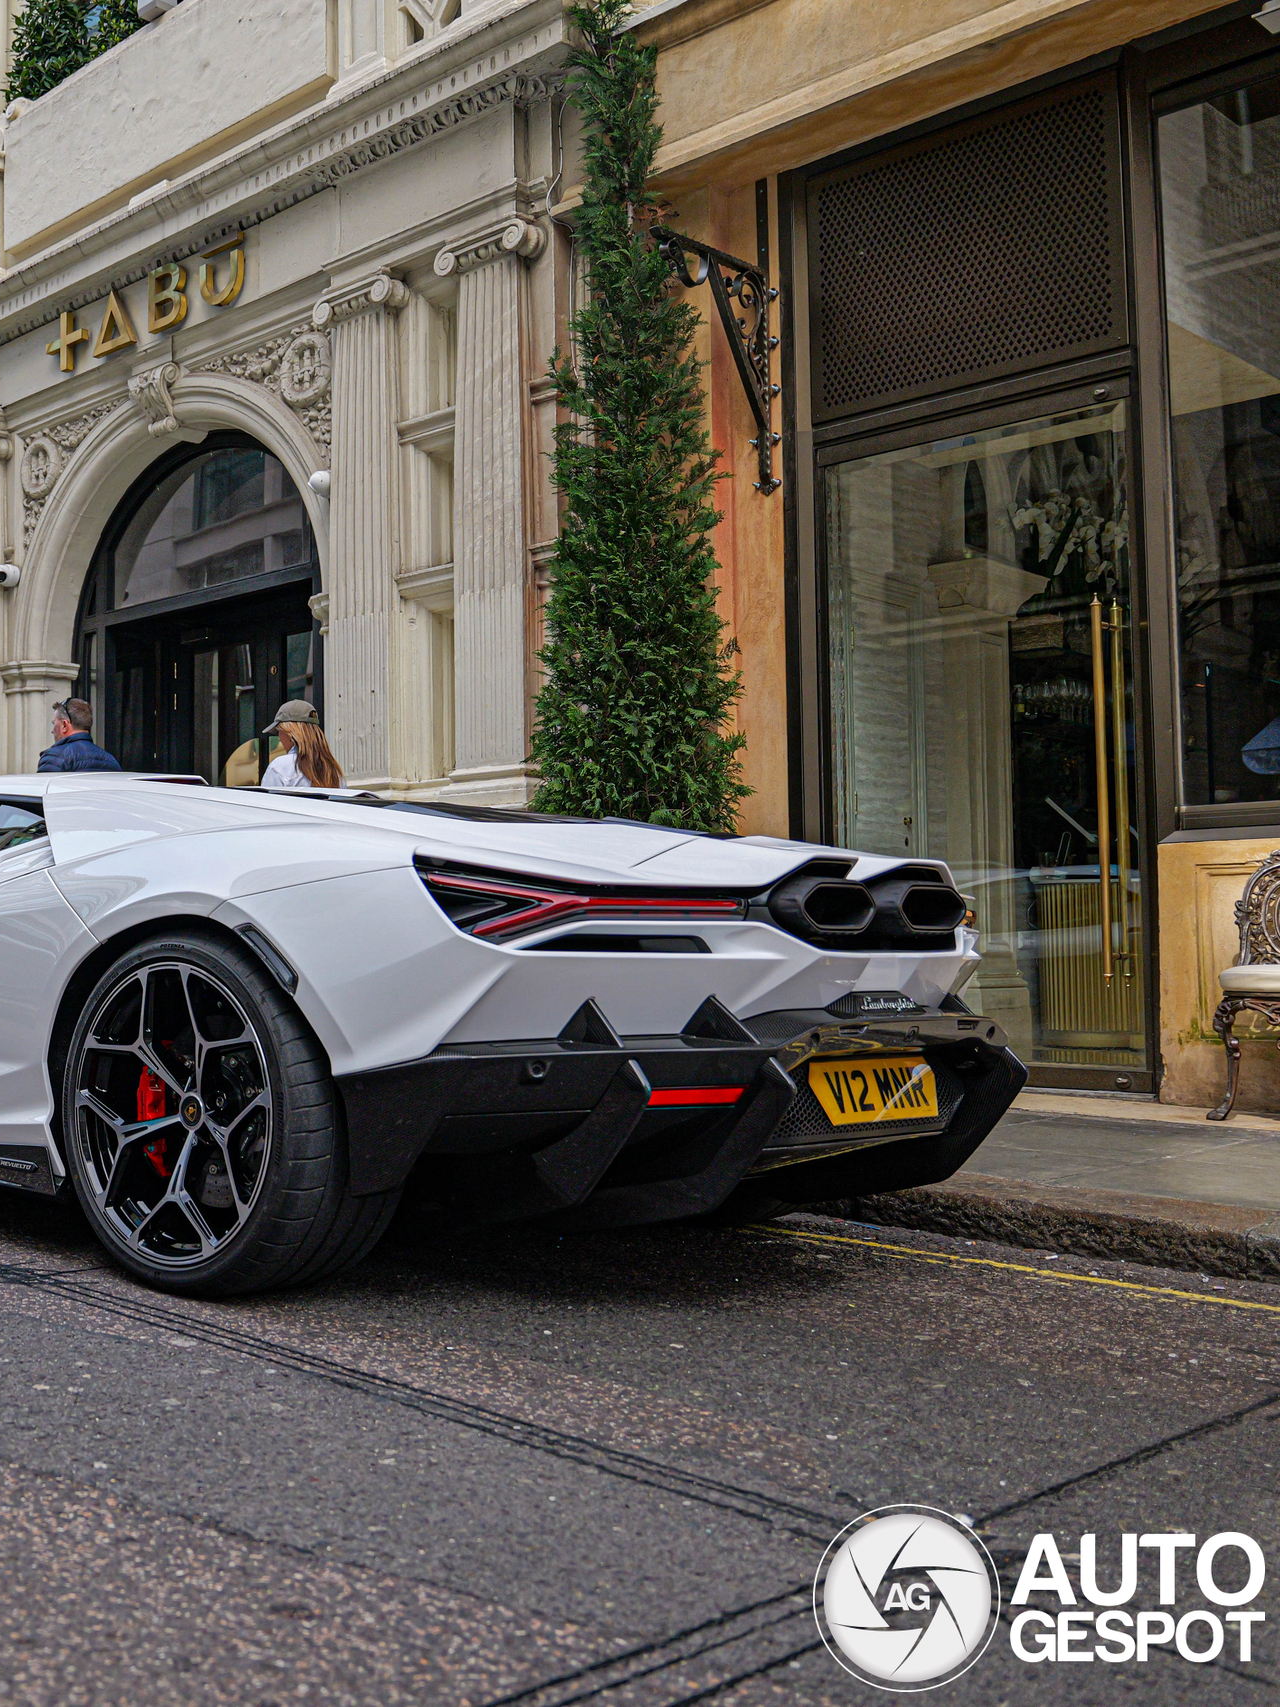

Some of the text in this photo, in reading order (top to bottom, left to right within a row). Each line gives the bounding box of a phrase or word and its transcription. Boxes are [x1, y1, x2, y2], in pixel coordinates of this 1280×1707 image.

[860, 996, 916, 1012] Lamborghini
[823, 1070, 876, 1114] V12
[0, 1160, 32, 1170] REVUELTO
